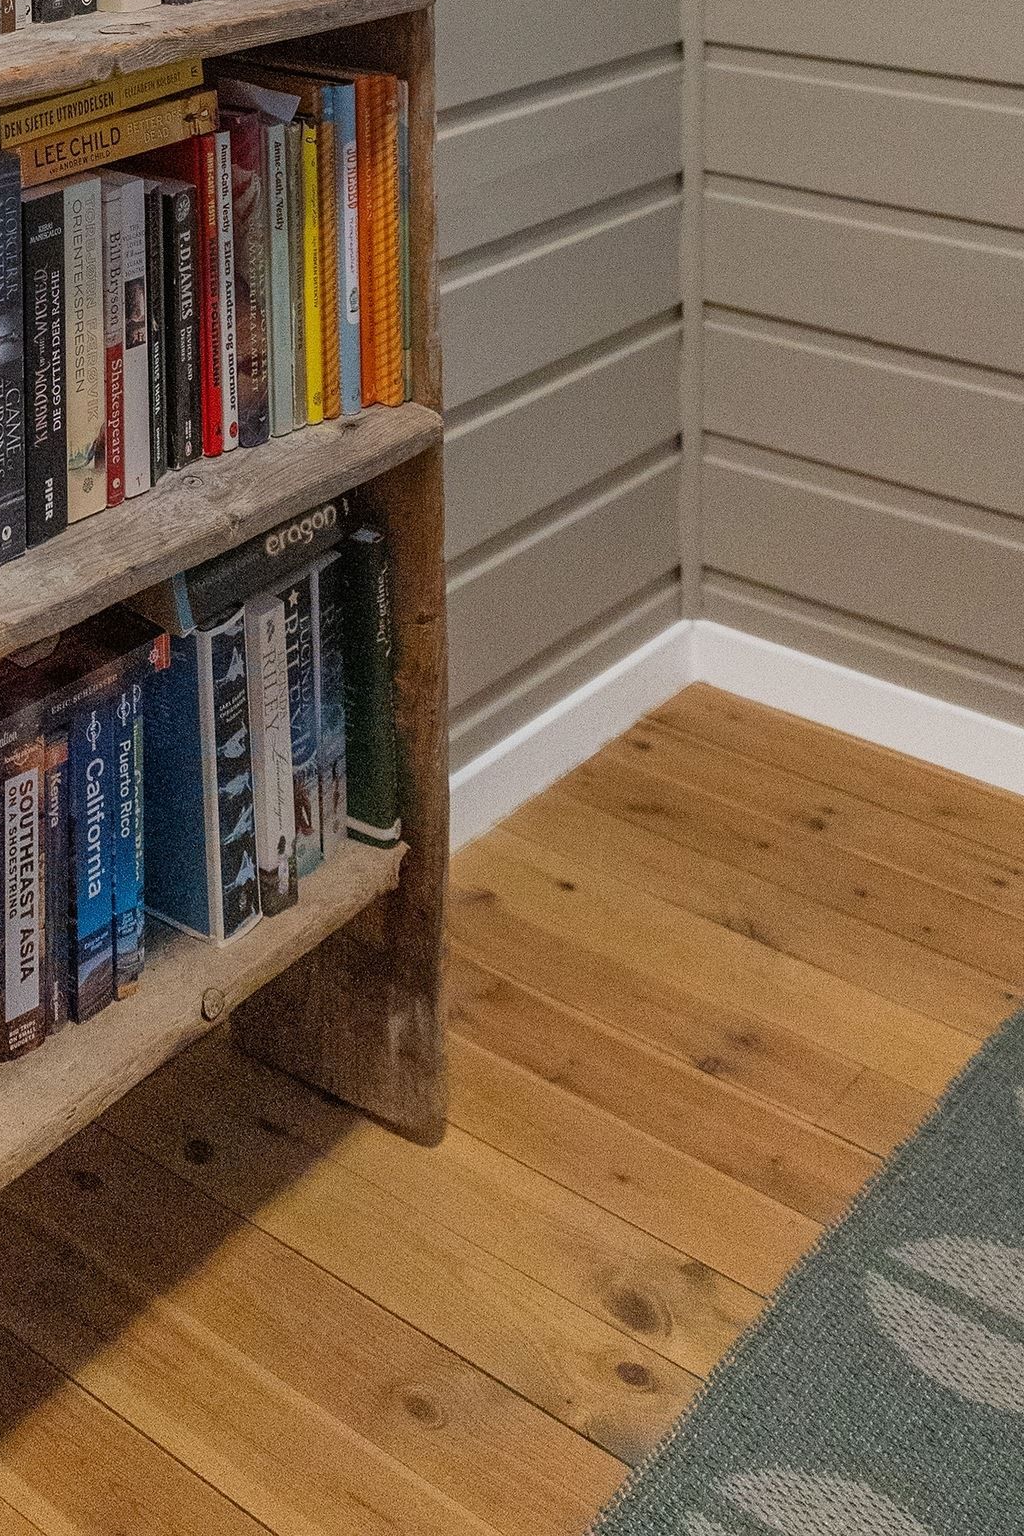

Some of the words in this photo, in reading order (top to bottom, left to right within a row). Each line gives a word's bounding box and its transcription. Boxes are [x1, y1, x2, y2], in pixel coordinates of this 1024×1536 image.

[4, 120, 23, 139] DEN
[23, 109, 54, 132] SJETTE
[55, 90, 114, 121] UTRYDDELSEN
[144, 123, 170, 143] DEAD
[33, 138, 66, 167] LEE
[69, 125, 122, 156] CHILD
[59, 152, 88, 170] ANDREW
[90, 147, 111, 162] CHILD
[220, 144, 229, 200] Anne-Cath.
[274, 141, 284, 195] Anne-Cath.
[5, 196, 18, 262] GEORGE
[222, 202, 231, 234] Vestly
[275, 199, 285, 231] Vestly
[84, 193, 97, 310] TORBJØRN
[109, 231, 122, 263] Bill
[223, 240, 233, 276] Ellen
[32, 269, 49, 345] WICKED
[50, 270, 61, 315] RACHE
[72, 199, 86, 394] ORIENTEKSPRESSEN
[106, 267, 122, 327] Bryson
[225, 279, 234, 329] Andrea
[51, 317, 61, 348] DER
[225, 333, 235, 351] og
[32, 362, 51, 448] KINGDOM
[228, 353, 237, 411] mormor
[5, 388, 21, 458] GAME
[52, 407, 62, 432] DIE
[107, 358, 123, 464] Shakespeare
[44, 476, 54, 522] PIPER
[265, 504, 337, 556] eragon
[262, 648, 279, 732] RILEY
[299, 614, 311, 720] LUCINDA
[118, 739, 132, 798] Puerto
[9, 786, 18, 808] ON
[9, 813, 18, 824] A
[48, 771, 62, 828] Kenya
[120, 800, 132, 839] Rico
[19, 779, 35, 919] SOUTHEAST
[86, 757, 105, 899] California
[8, 826, 18, 920] SHOESTRING
[19, 928, 35, 983] ASIA
